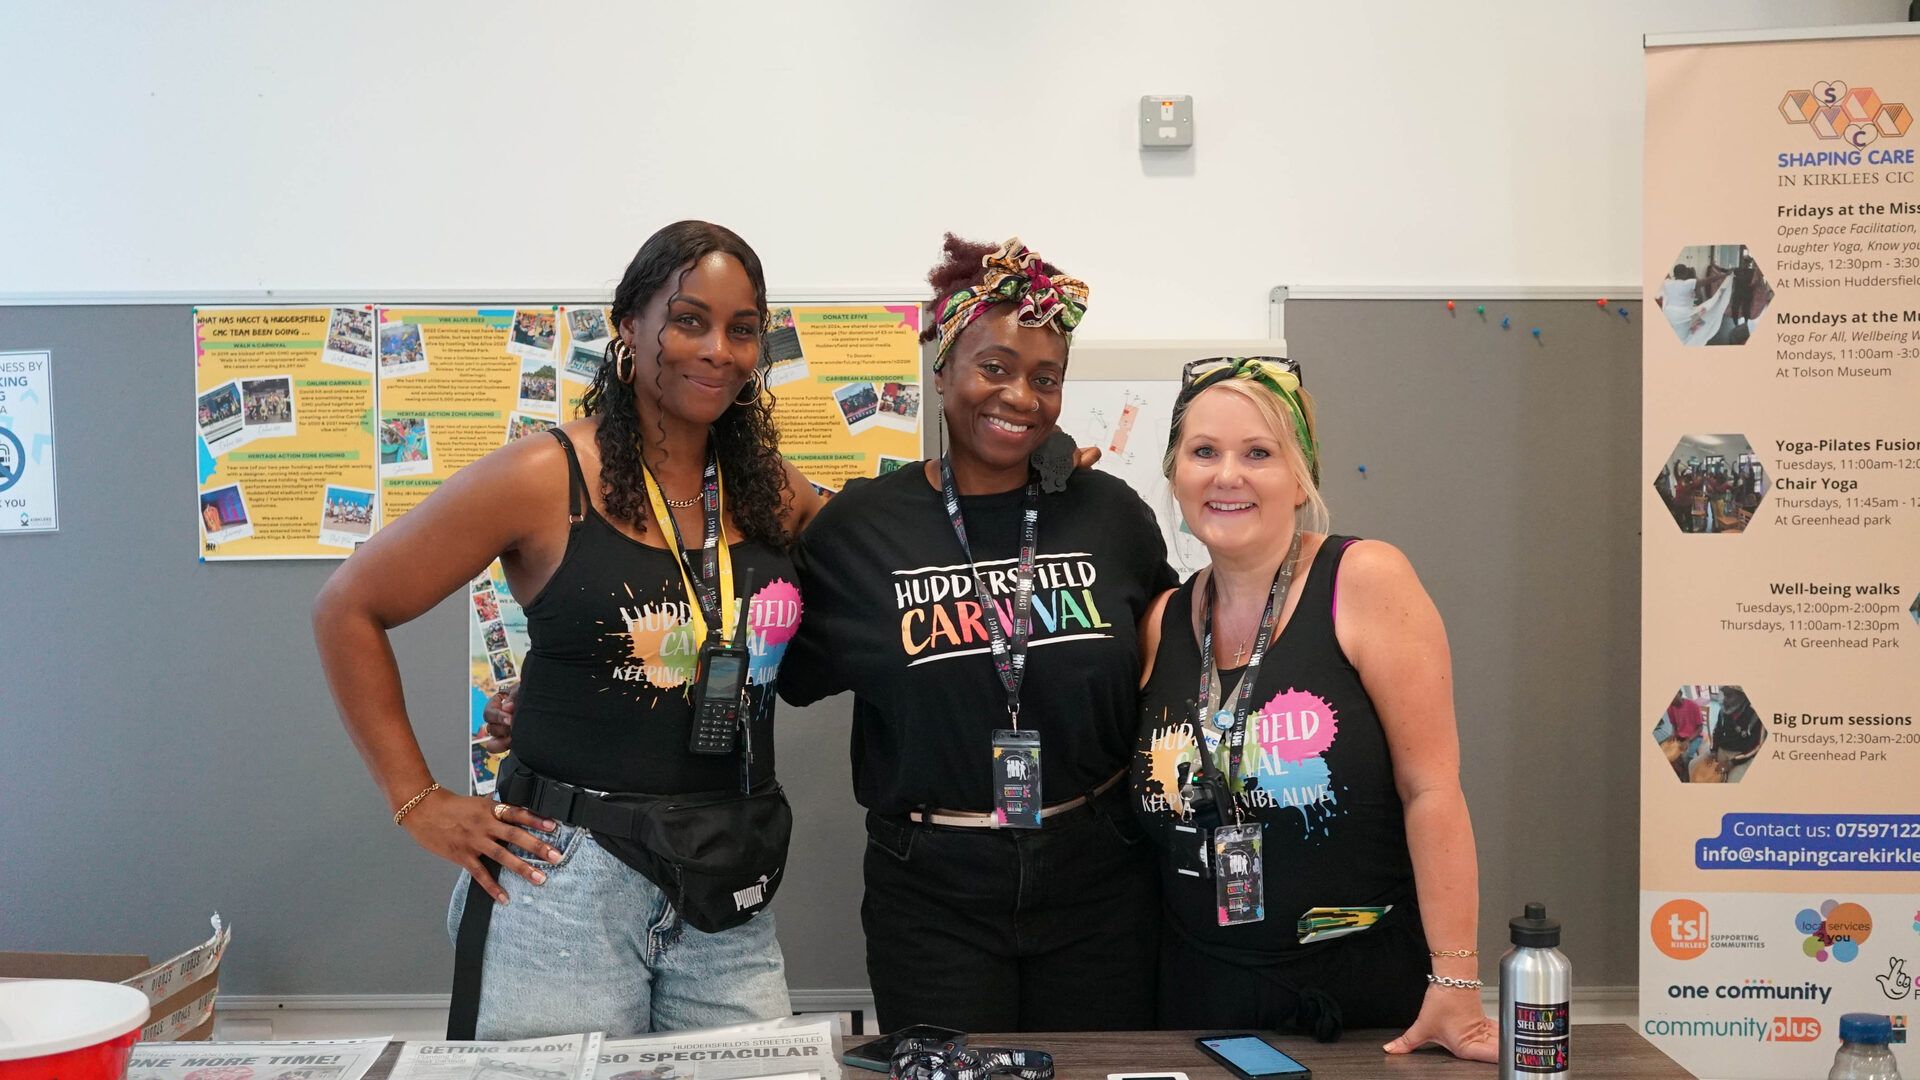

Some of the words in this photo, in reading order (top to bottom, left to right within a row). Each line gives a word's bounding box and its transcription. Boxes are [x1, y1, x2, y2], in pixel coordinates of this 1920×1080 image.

[1824, 87, 1836, 103] S
[1852, 131, 1866, 147] C
[1778, 151, 1862, 168] SHAPING
[1868, 149, 1914, 164] CARE
[1778, 175, 1796, 187] IN
[1803, 172, 1879, 186] KIRKLEES
[1886, 172, 1914, 184] CIC
[1778, 204, 1834, 220] Fridays
[1838, 205, 1854, 216] at
[1859, 203, 1885, 215] the
[1777, 225, 1808, 238] Open
[1812, 224, 1847, 238] Space
[1850, 222, 1917, 234] Facilitation,
[1777, 242, 1829, 256] Laughter
[1833, 242, 1864, 254] Yoga,
[1868, 241, 1900, 252] Know
[1777, 260, 1824, 272] Fridays,
[1829, 258, 1882, 272] 12:30pm
[1776, 278, 1790, 288] At
[1794, 277, 1840, 288] Mission
[197, 316, 217, 324] WHAT
[219, 316, 234, 324] HAS
[236, 316, 260, 324] HACCT
[1777, 312, 1848, 326] Mondays
[1852, 312, 1868, 323] at
[1872, 310, 1898, 322] the
[252, 328, 273, 336] BEEN
[275, 328, 300, 336] DOING
[1777, 333, 1805, 345] Yoga
[1808, 332, 1828, 342] For
[1830, 332, 1848, 343] All,
[1852, 330, 1908, 344] Wellbeing
[1776, 350, 1836, 362] Mondays,
[1841, 348, 1893, 359] 11:00am
[28, 361, 43, 372] BY
[1776, 368, 1790, 378] At
[1792, 366, 1834, 378] Tolson
[1838, 366, 1892, 377] Museum
[1776, 439, 1871, 455] Yoga-Pilates
[1776, 460, 1836, 472] Tuesdays,
[1776, 478, 1817, 490] Chair
[1822, 478, 1858, 492] Yoga
[5, 499, 26, 508] YOU
[1774, 498, 1842, 510] Thursdays,
[1846, 497, 1898, 508] 11:45am
[1774, 516, 1788, 526] At
[1792, 514, 1860, 526] Greenhead
[1864, 515, 1892, 528] park
[1770, 583, 1852, 598] Well-being
[1855, 583, 1900, 595] walks
[1720, 620, 1786, 634] Thursdays,
[1790, 620, 1900, 634] 11:00am-12:30pm
[1784, 638, 1798, 648] At
[1800, 637, 1868, 648] Greenhead
[1872, 637, 1900, 648] Park
[1773, 713, 1797, 728] Big
[1802, 714, 1844, 725] Drum
[1848, 714, 1912, 726] sessions
[1772, 750, 1785, 760] At
[1788, 750, 1856, 760] Greenhead
[1860, 750, 1888, 761] Park
[1240, 788, 1279, 809] VIBE
[1282, 783, 1331, 807] ALIVE
[1734, 822, 1801, 838] Contact
[1806, 824, 1831, 838] us:
[732, 884, 764, 912] PUMA
[1668, 912, 1707, 940] tsl
[1802, 921, 1826, 931] local
[1828, 921, 1871, 932] services
[1827, 934, 1850, 944] you
[1668, 984, 1710, 999] one
[1715, 982, 1832, 1004] community
[1518, 1010, 1554, 1022] LEGACY
[1516, 1020, 1536, 1030] STEEL
[1536, 1021, 1554, 1030] BAND
[420, 1046, 500, 1054] GETTING
[506, 1043, 573, 1053] READY!
[673, 1040, 750, 1050] HUDDERSFIELD'S
[752, 1038, 792, 1046] STREETS
[794, 1036, 824, 1044] FILLED
[598, 1054, 630, 1064] SO
[639, 1046, 818, 1062] SPECTACULAR
[1516, 1046, 1556, 1056] HUDDERSFIELD
[180, 1057, 260, 1067] MORE
[268, 1055, 340, 1066] TIME!
[1516, 1053, 1556, 1066] CARNIVAL
